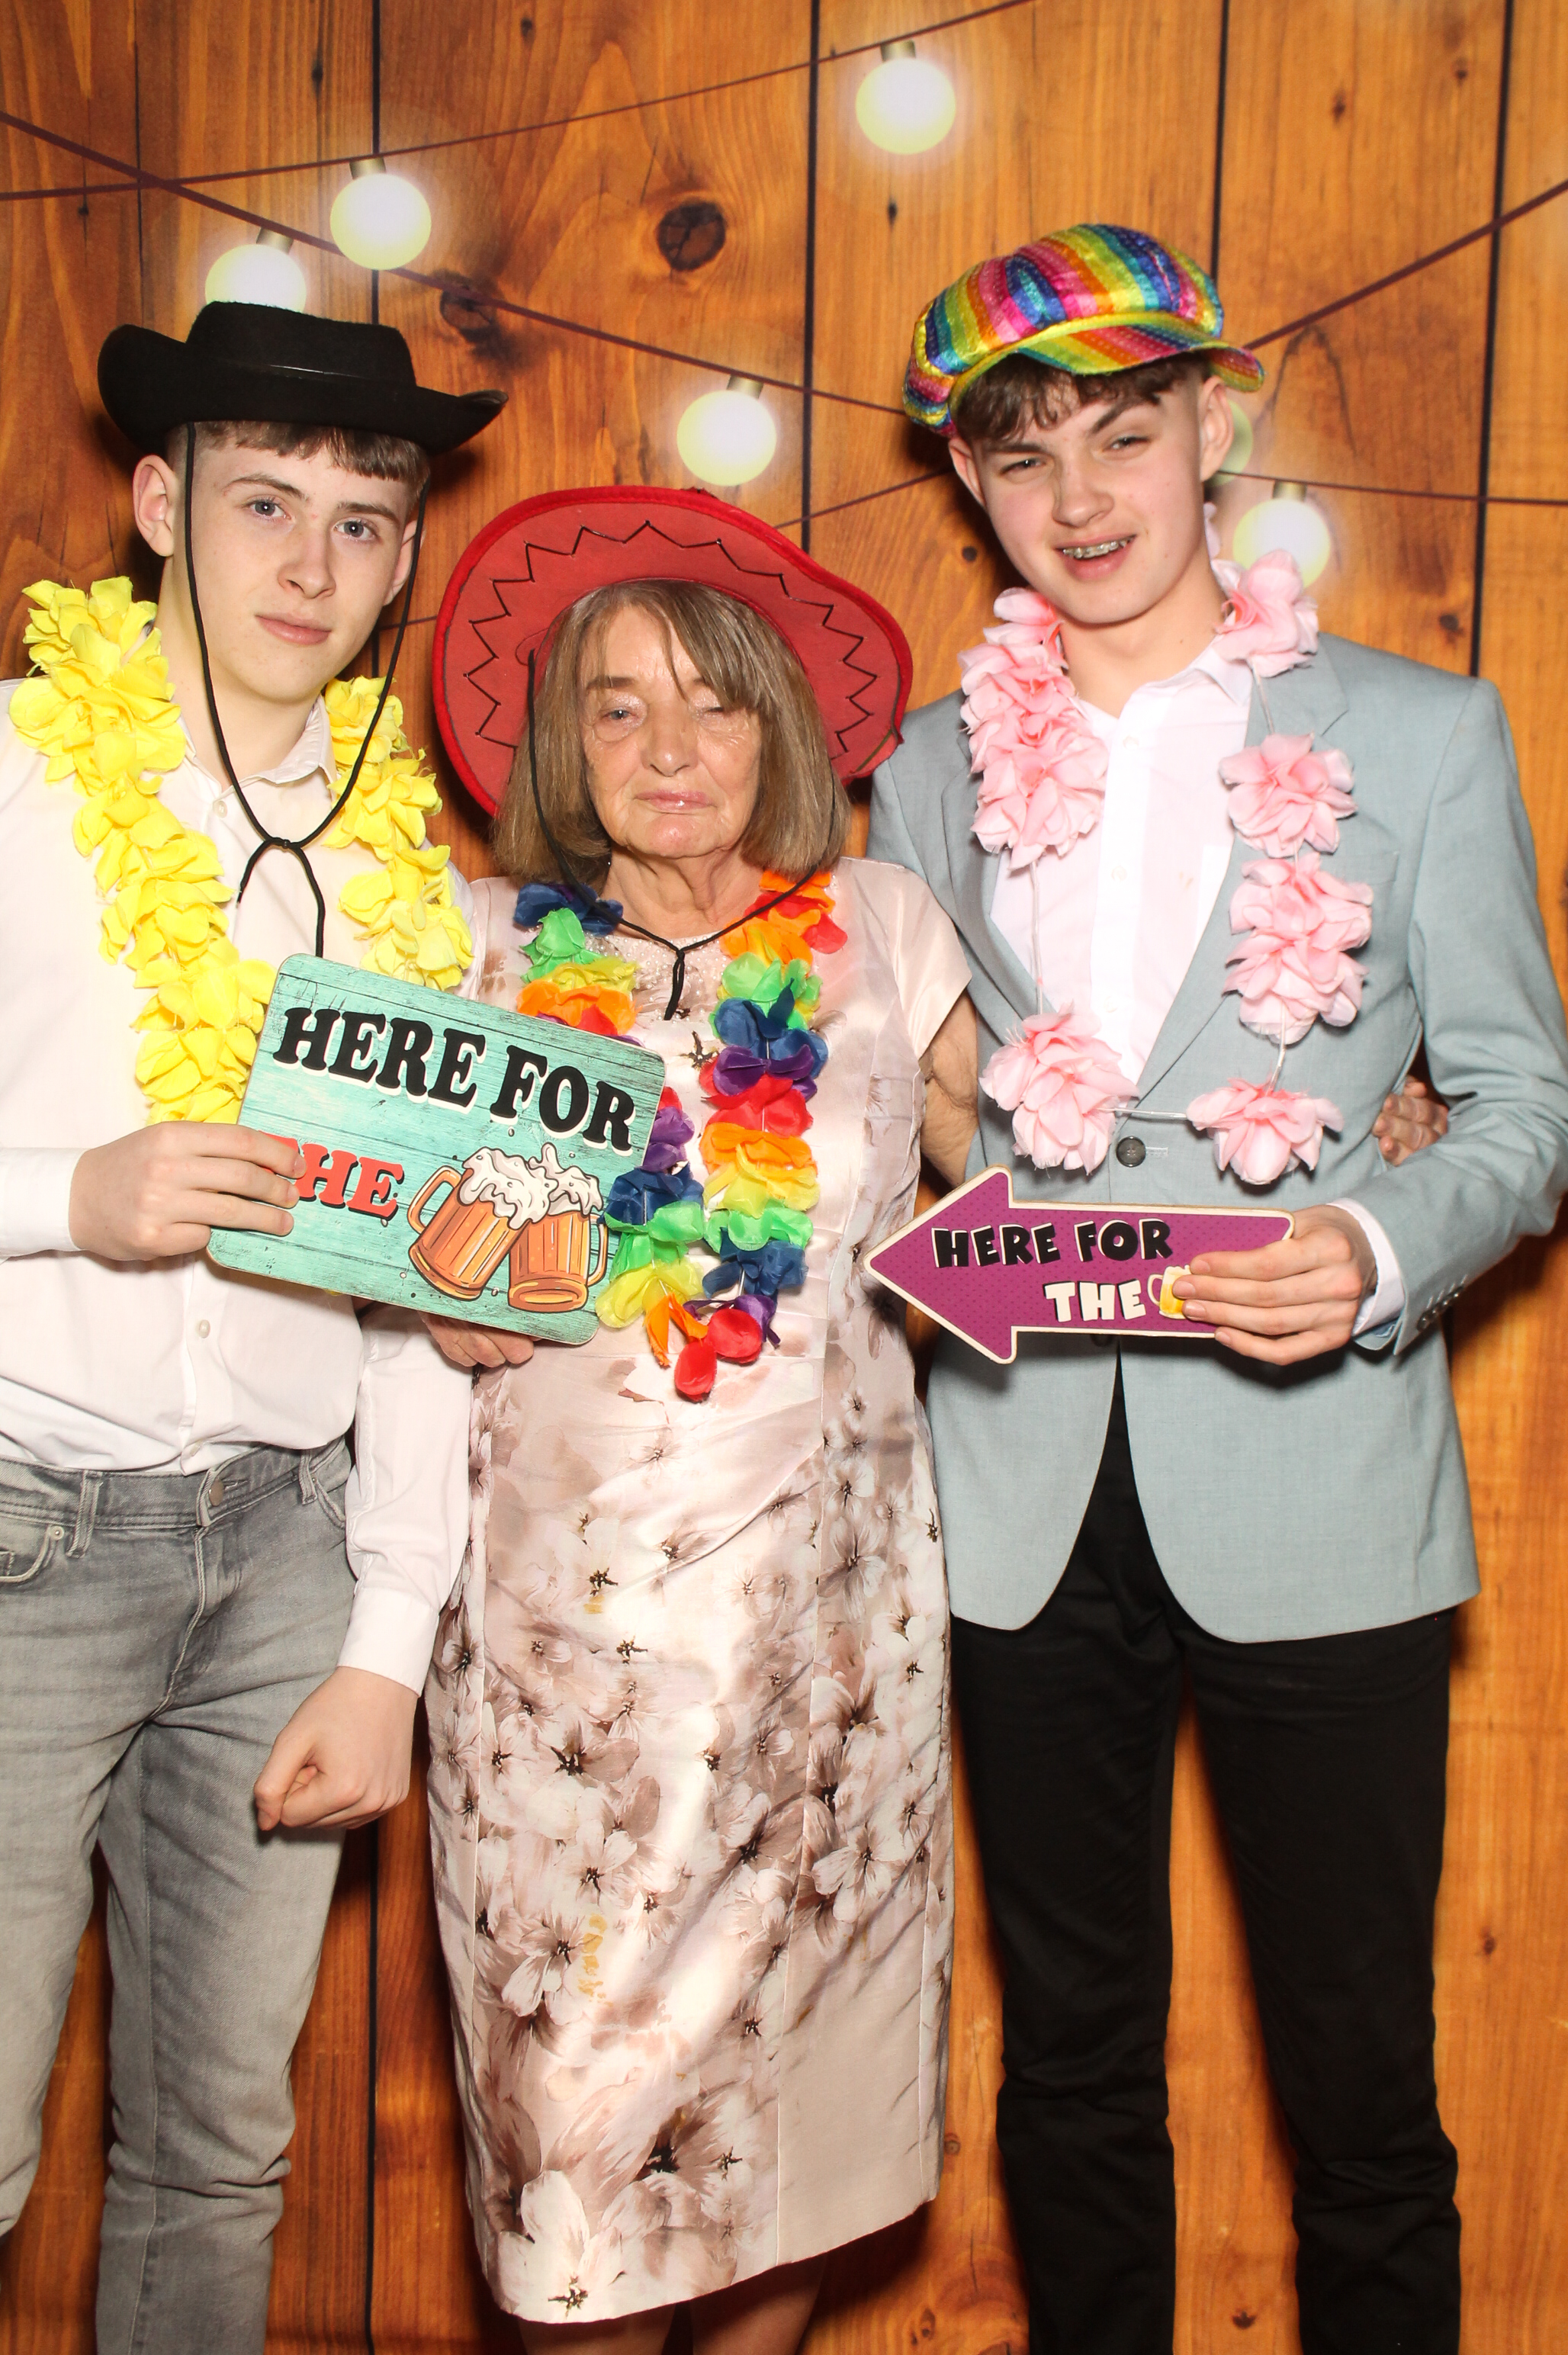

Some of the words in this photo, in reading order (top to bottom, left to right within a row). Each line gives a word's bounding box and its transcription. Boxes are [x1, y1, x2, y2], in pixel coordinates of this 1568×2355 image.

[272, 1006, 486, 1113] HERE
[490, 1045, 635, 1155] FOR
[931, 1222, 1061, 1268] HERE
[1074, 1218, 1172, 1262] FOR
[1044, 1279, 1146, 1322] THE
